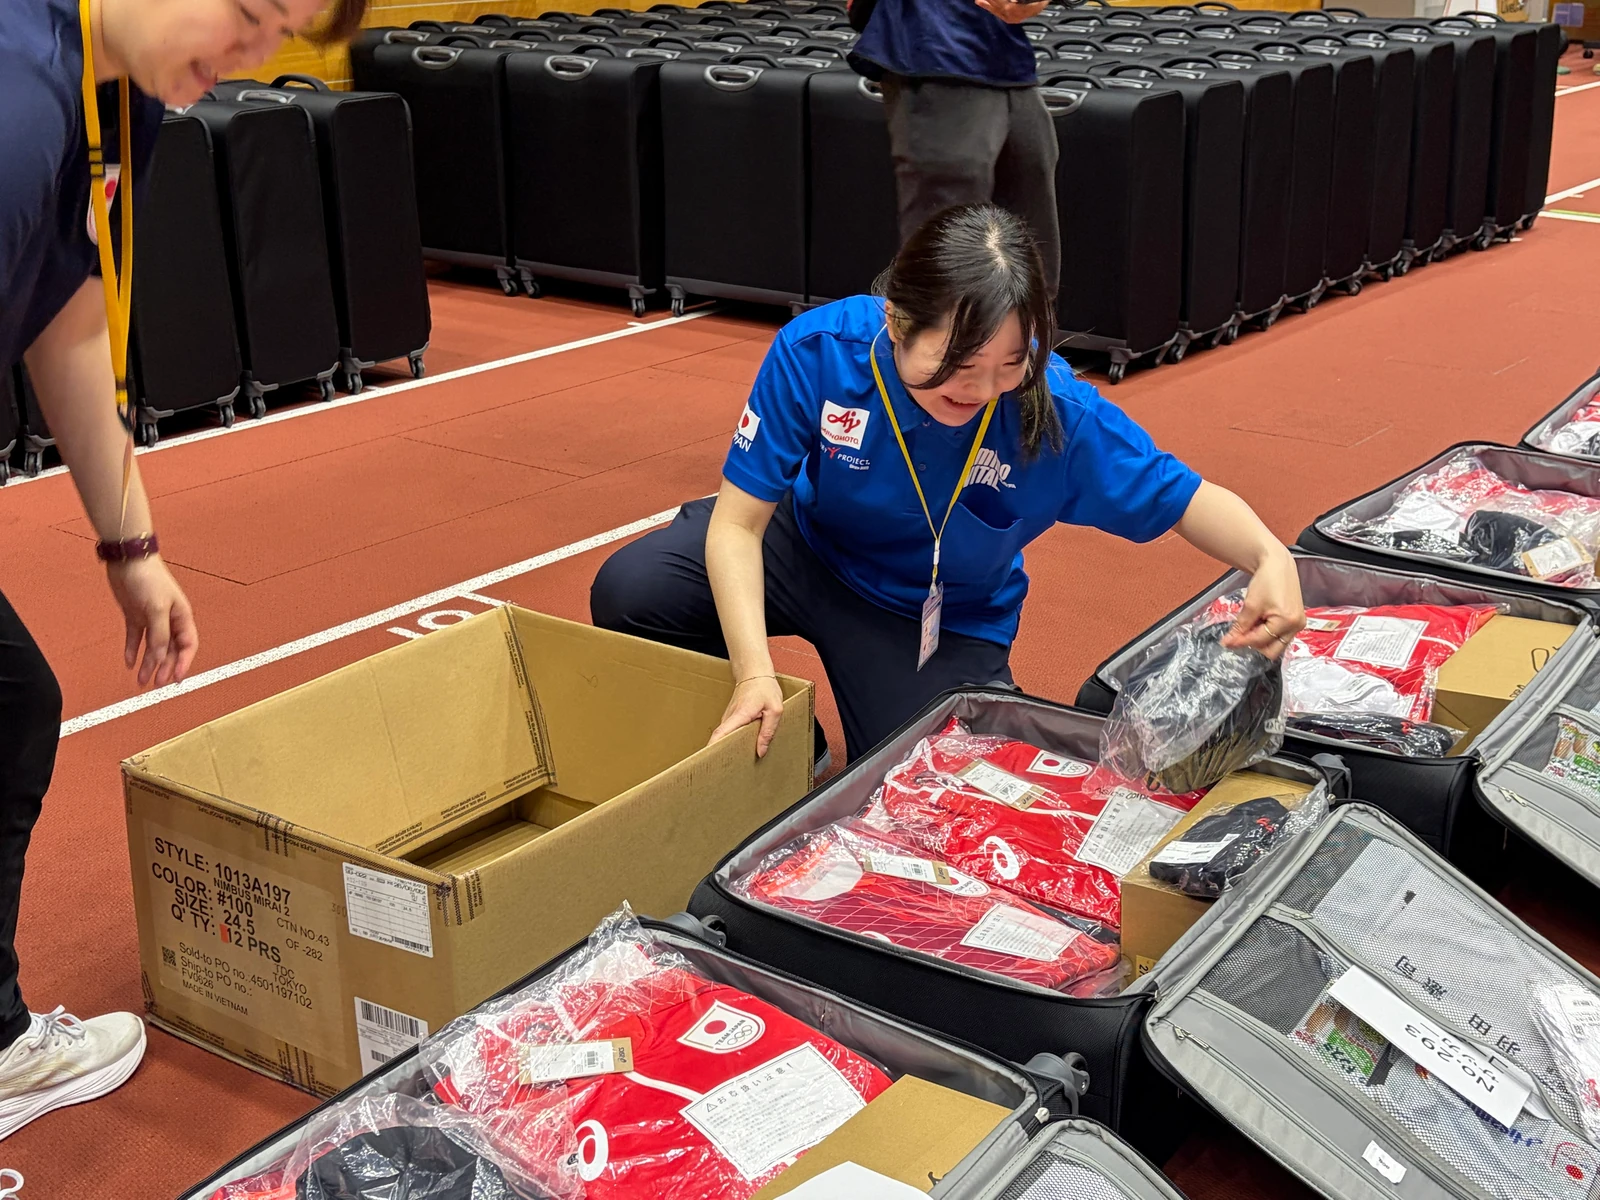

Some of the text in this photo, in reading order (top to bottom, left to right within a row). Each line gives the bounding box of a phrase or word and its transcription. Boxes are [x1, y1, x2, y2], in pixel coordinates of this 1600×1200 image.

[837, 453, 869, 466] PROJECT
[154, 837, 291, 905] STYLE: 1013A197
[152, 862, 253, 918] COLOR: #100
[213, 877, 290, 917] NIMBUS MIRAI 2
[175, 888, 255, 936] SIZE: 24.5
[276, 917, 297, 933] CTN
[180, 942, 212, 966] Sold-to
[214, 957, 230, 973] PO
[227, 927, 243, 948] 12
[248, 936, 281, 963] PRS
[285, 938, 323, 962] OF -282
[180, 956, 214, 979] Ship-to
[216, 972, 231, 987] PO
[273, 972, 307, 995] TOKYO
[274, 963, 295, 980] TDC
[182, 979, 248, 1016] MADE IN VIETNAM
[715, 1019, 746, 1046] TEAM JAPAN
[1405, 1024, 1496, 1093] No.293
[1420, 1022, 1500, 1083] サッカー
